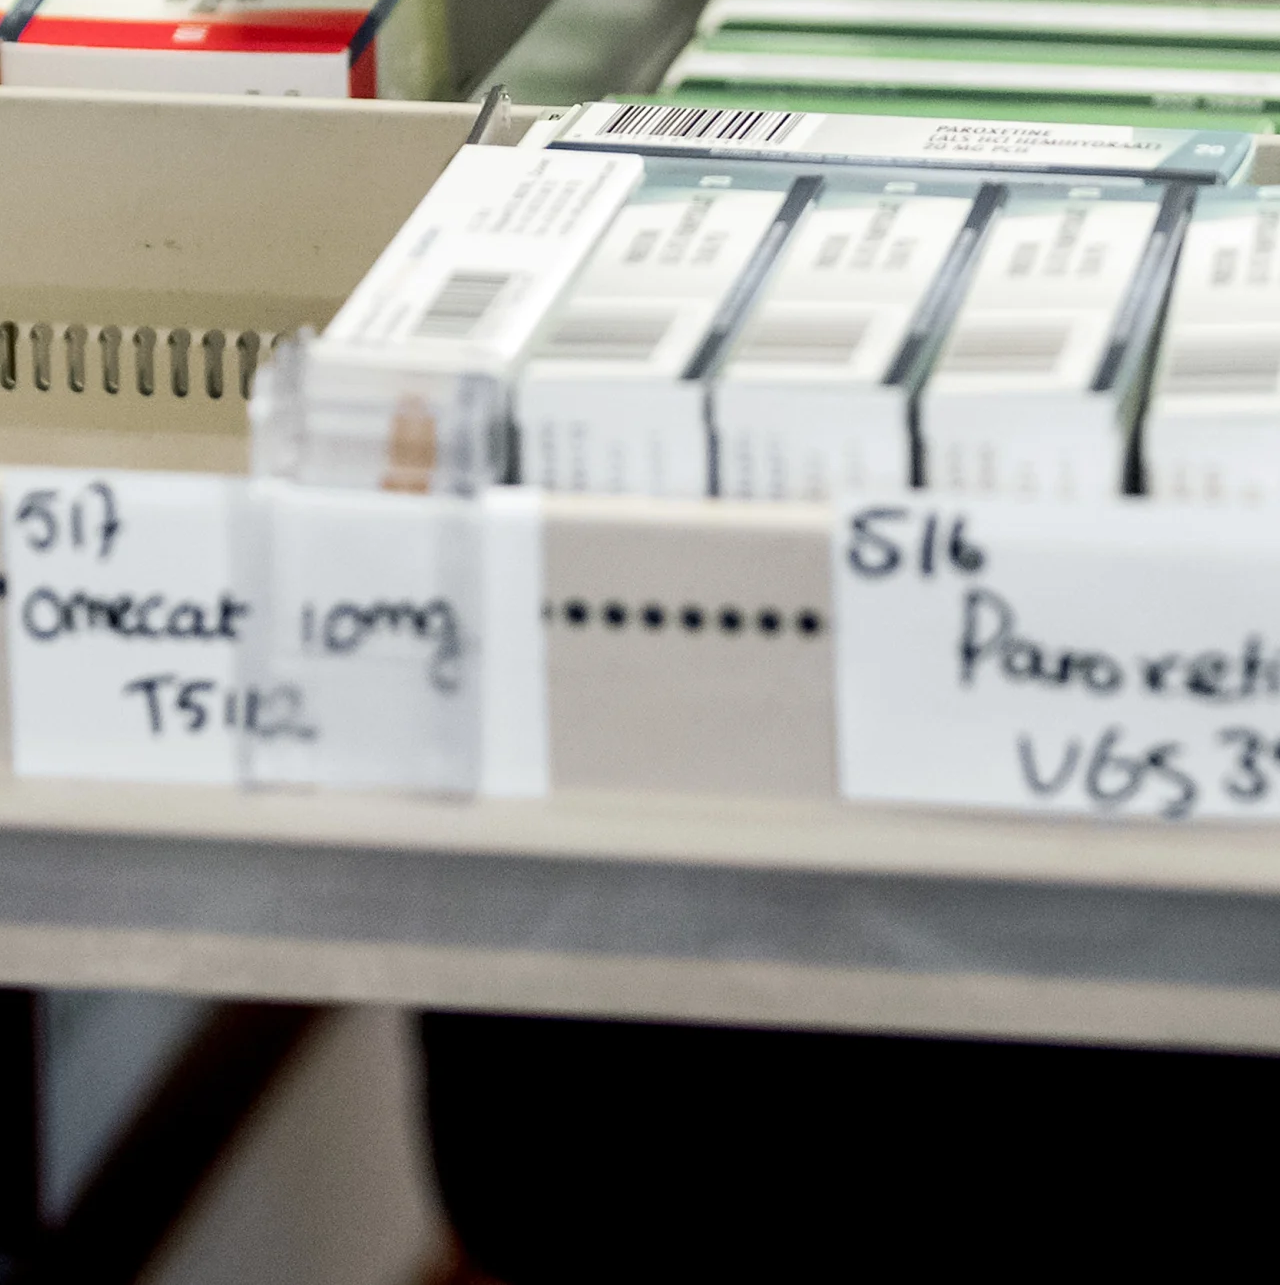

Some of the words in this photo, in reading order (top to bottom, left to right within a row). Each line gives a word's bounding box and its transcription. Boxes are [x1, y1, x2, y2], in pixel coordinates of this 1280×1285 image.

[935, 124, 1053, 137] PAROXETINE
[17, 481, 122, 558] 517
[847, 505, 985, 579] 516
[22, 586, 250, 642] Omecat
